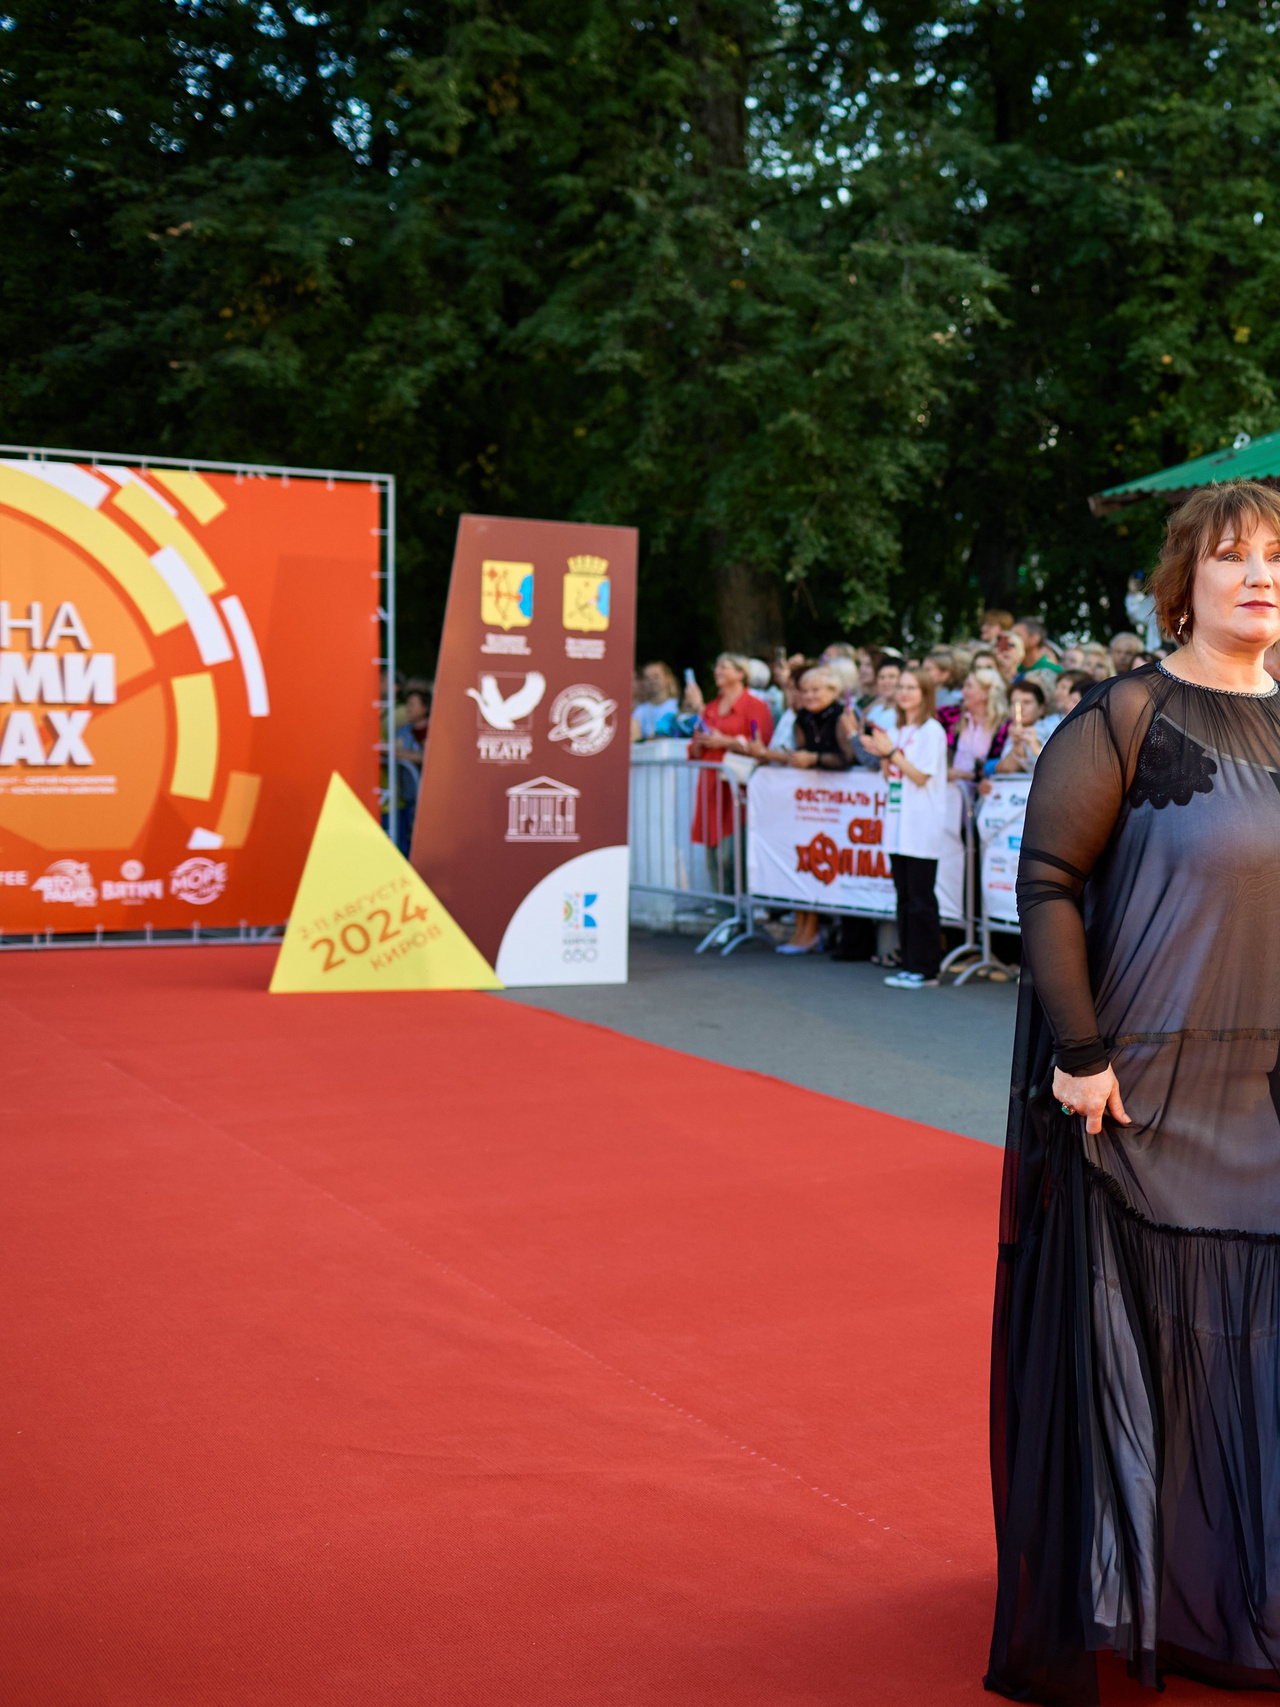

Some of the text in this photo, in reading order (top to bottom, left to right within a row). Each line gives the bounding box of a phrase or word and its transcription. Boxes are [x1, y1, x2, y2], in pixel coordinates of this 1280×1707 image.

[0, 600, 93, 650] НА
[334, 877, 411, 923] АВГУСТА
[310, 894, 429, 973] 2024
[371, 924, 442, 972] КИРОВ
